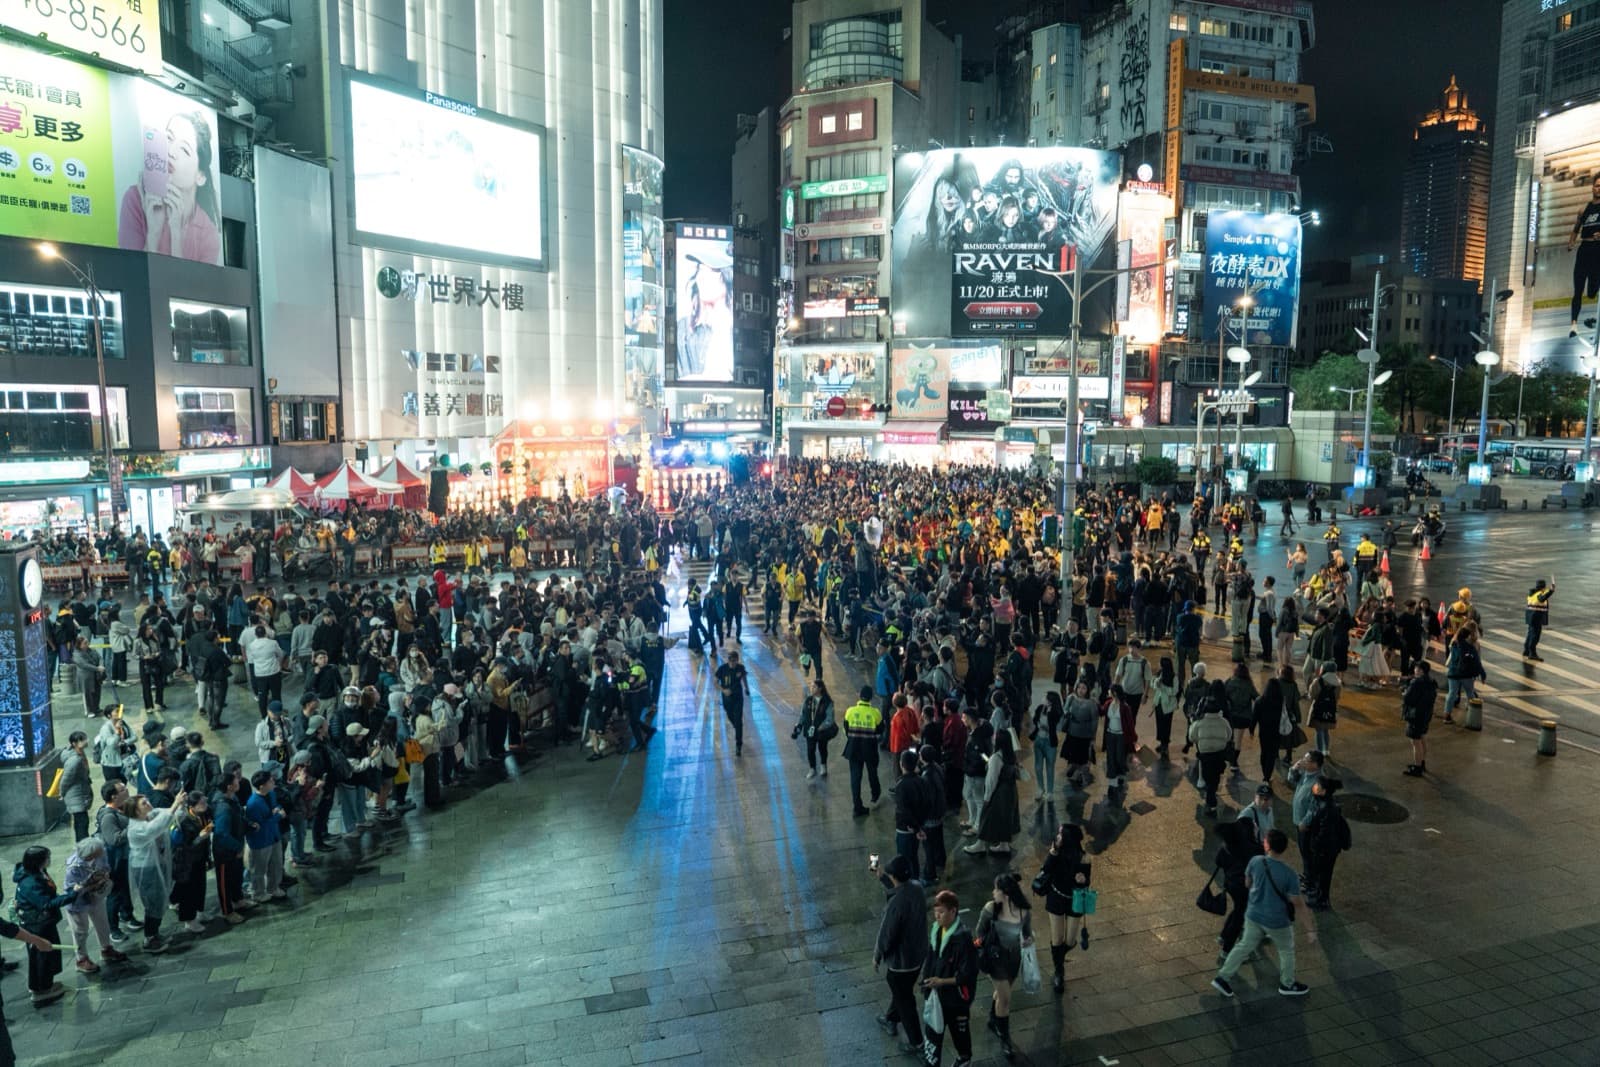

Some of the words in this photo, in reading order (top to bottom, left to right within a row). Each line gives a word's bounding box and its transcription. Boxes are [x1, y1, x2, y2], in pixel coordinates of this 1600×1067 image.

[425, 92, 477, 116] Panasonic
[33, 114, 84, 142] 更多
[953, 252, 1055, 276] RAVEN
[401, 269, 525, 312] 新世界大樓
[959, 285, 994, 298] 11/20
[997, 284, 1049, 299] 正式上市!
